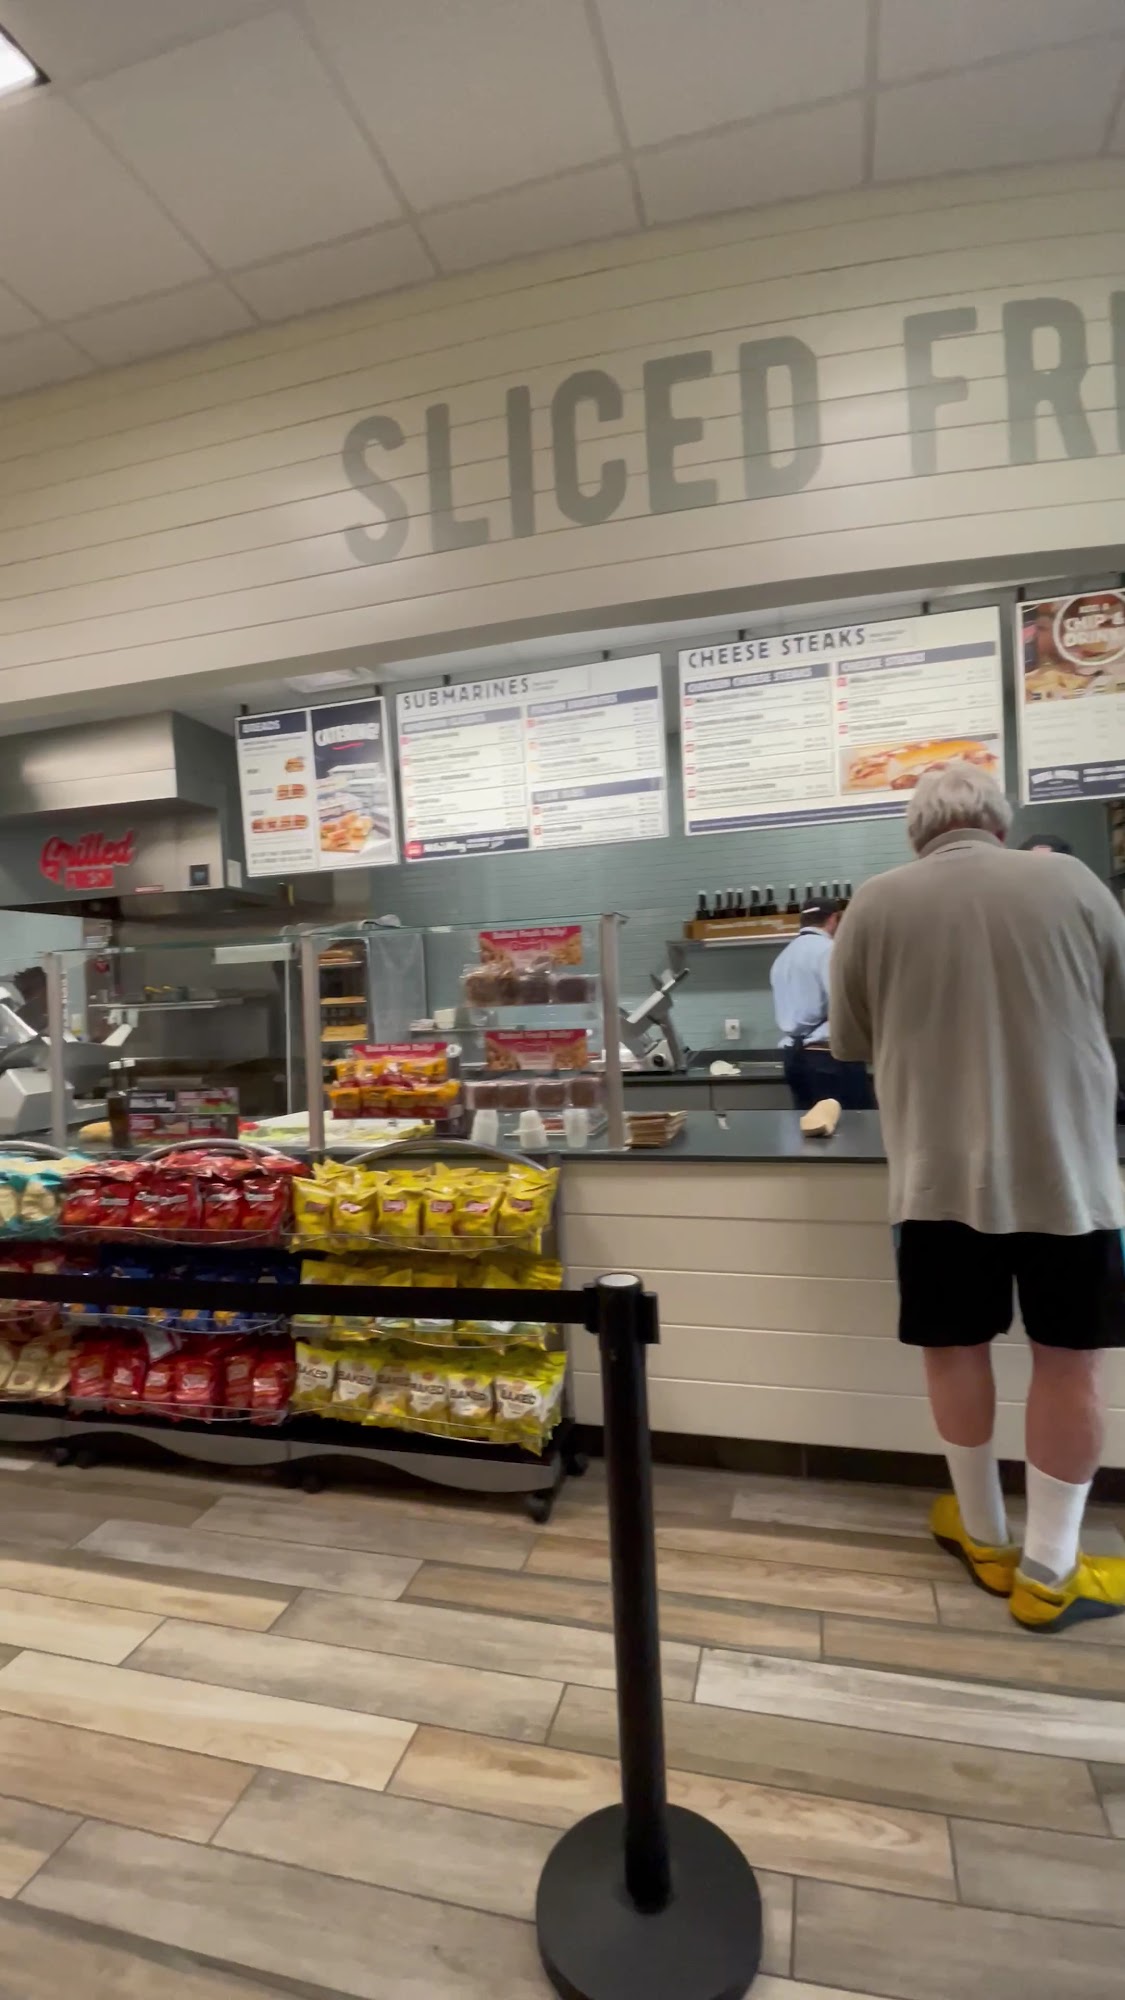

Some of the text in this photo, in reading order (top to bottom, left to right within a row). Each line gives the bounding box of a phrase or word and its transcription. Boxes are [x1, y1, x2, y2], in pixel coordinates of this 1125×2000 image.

[342, 334, 822, 566] SLICED
[688, 641, 769, 669] CHEESE
[781, 627, 865, 656] STEAKS
[403, 677, 529, 711] SUBMARINES
